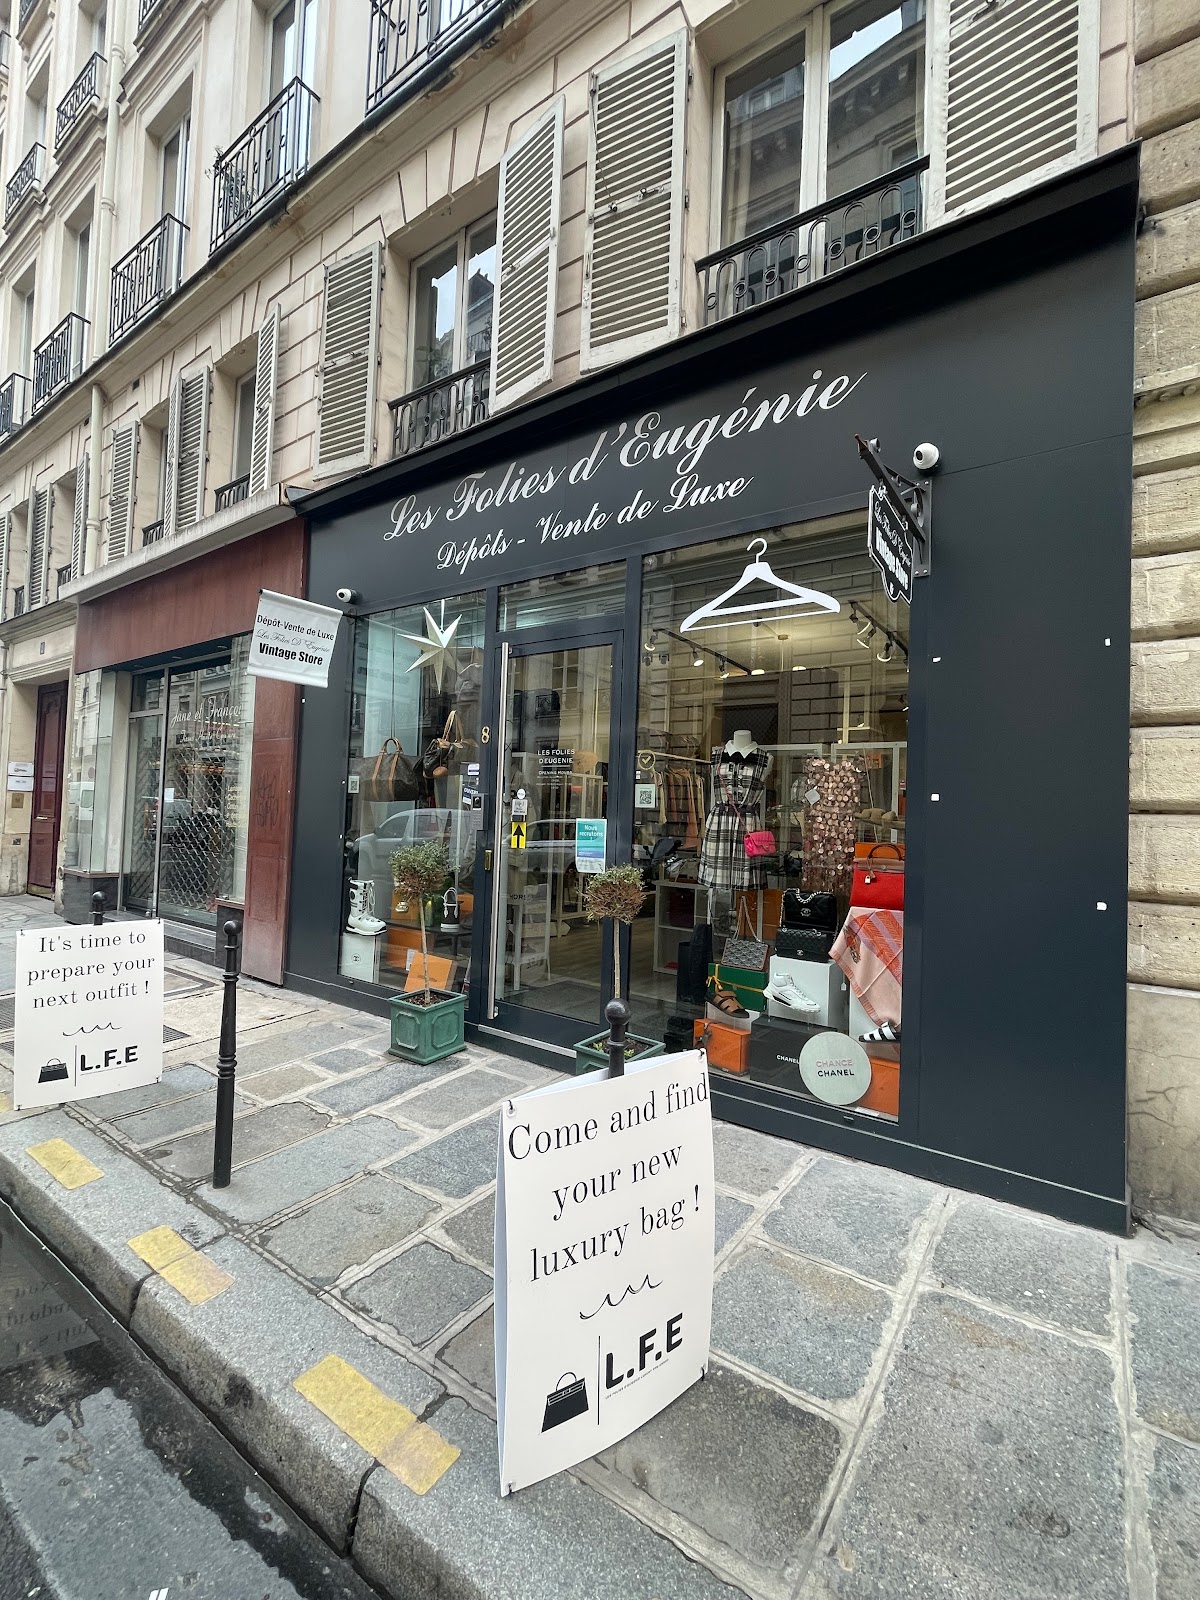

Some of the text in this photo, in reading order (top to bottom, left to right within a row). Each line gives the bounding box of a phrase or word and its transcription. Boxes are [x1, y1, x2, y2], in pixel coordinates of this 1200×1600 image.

[383, 496, 440, 541] Les
[446, 461, 568, 521] Folies
[436, 534, 513, 575] Dépôts
[535, 508, 613, 547] Vente
[617, 492, 659, 525] de
[662, 474, 754, 514] Luxe
[255, 628, 270, 639] Les
[257, 614, 334, 640] Dépôt-Vente de Luxe
[259, 642, 323, 666] Vintage Store
[170, 703, 192, 728] Jane
[206, 695, 241, 719] Françoi
[482, 726, 490, 744] 8
[39, 931, 146, 952] It's time to
[27, 957, 155, 986] prepare your
[33, 980, 149, 1009] next outfit !
[80, 1045, 138, 1072] L.F.E
[776, 1054, 800, 1064] CHANEL
[816, 1060, 854, 1068] CHANCE
[817, 1069, 854, 1078] CHANEL
[508, 1072, 710, 1160] Come and find
[552, 1145, 684, 1222] your new
[530, 1184, 700, 1283] luxury bag !
[605, 1312, 684, 1390] L.F.E
